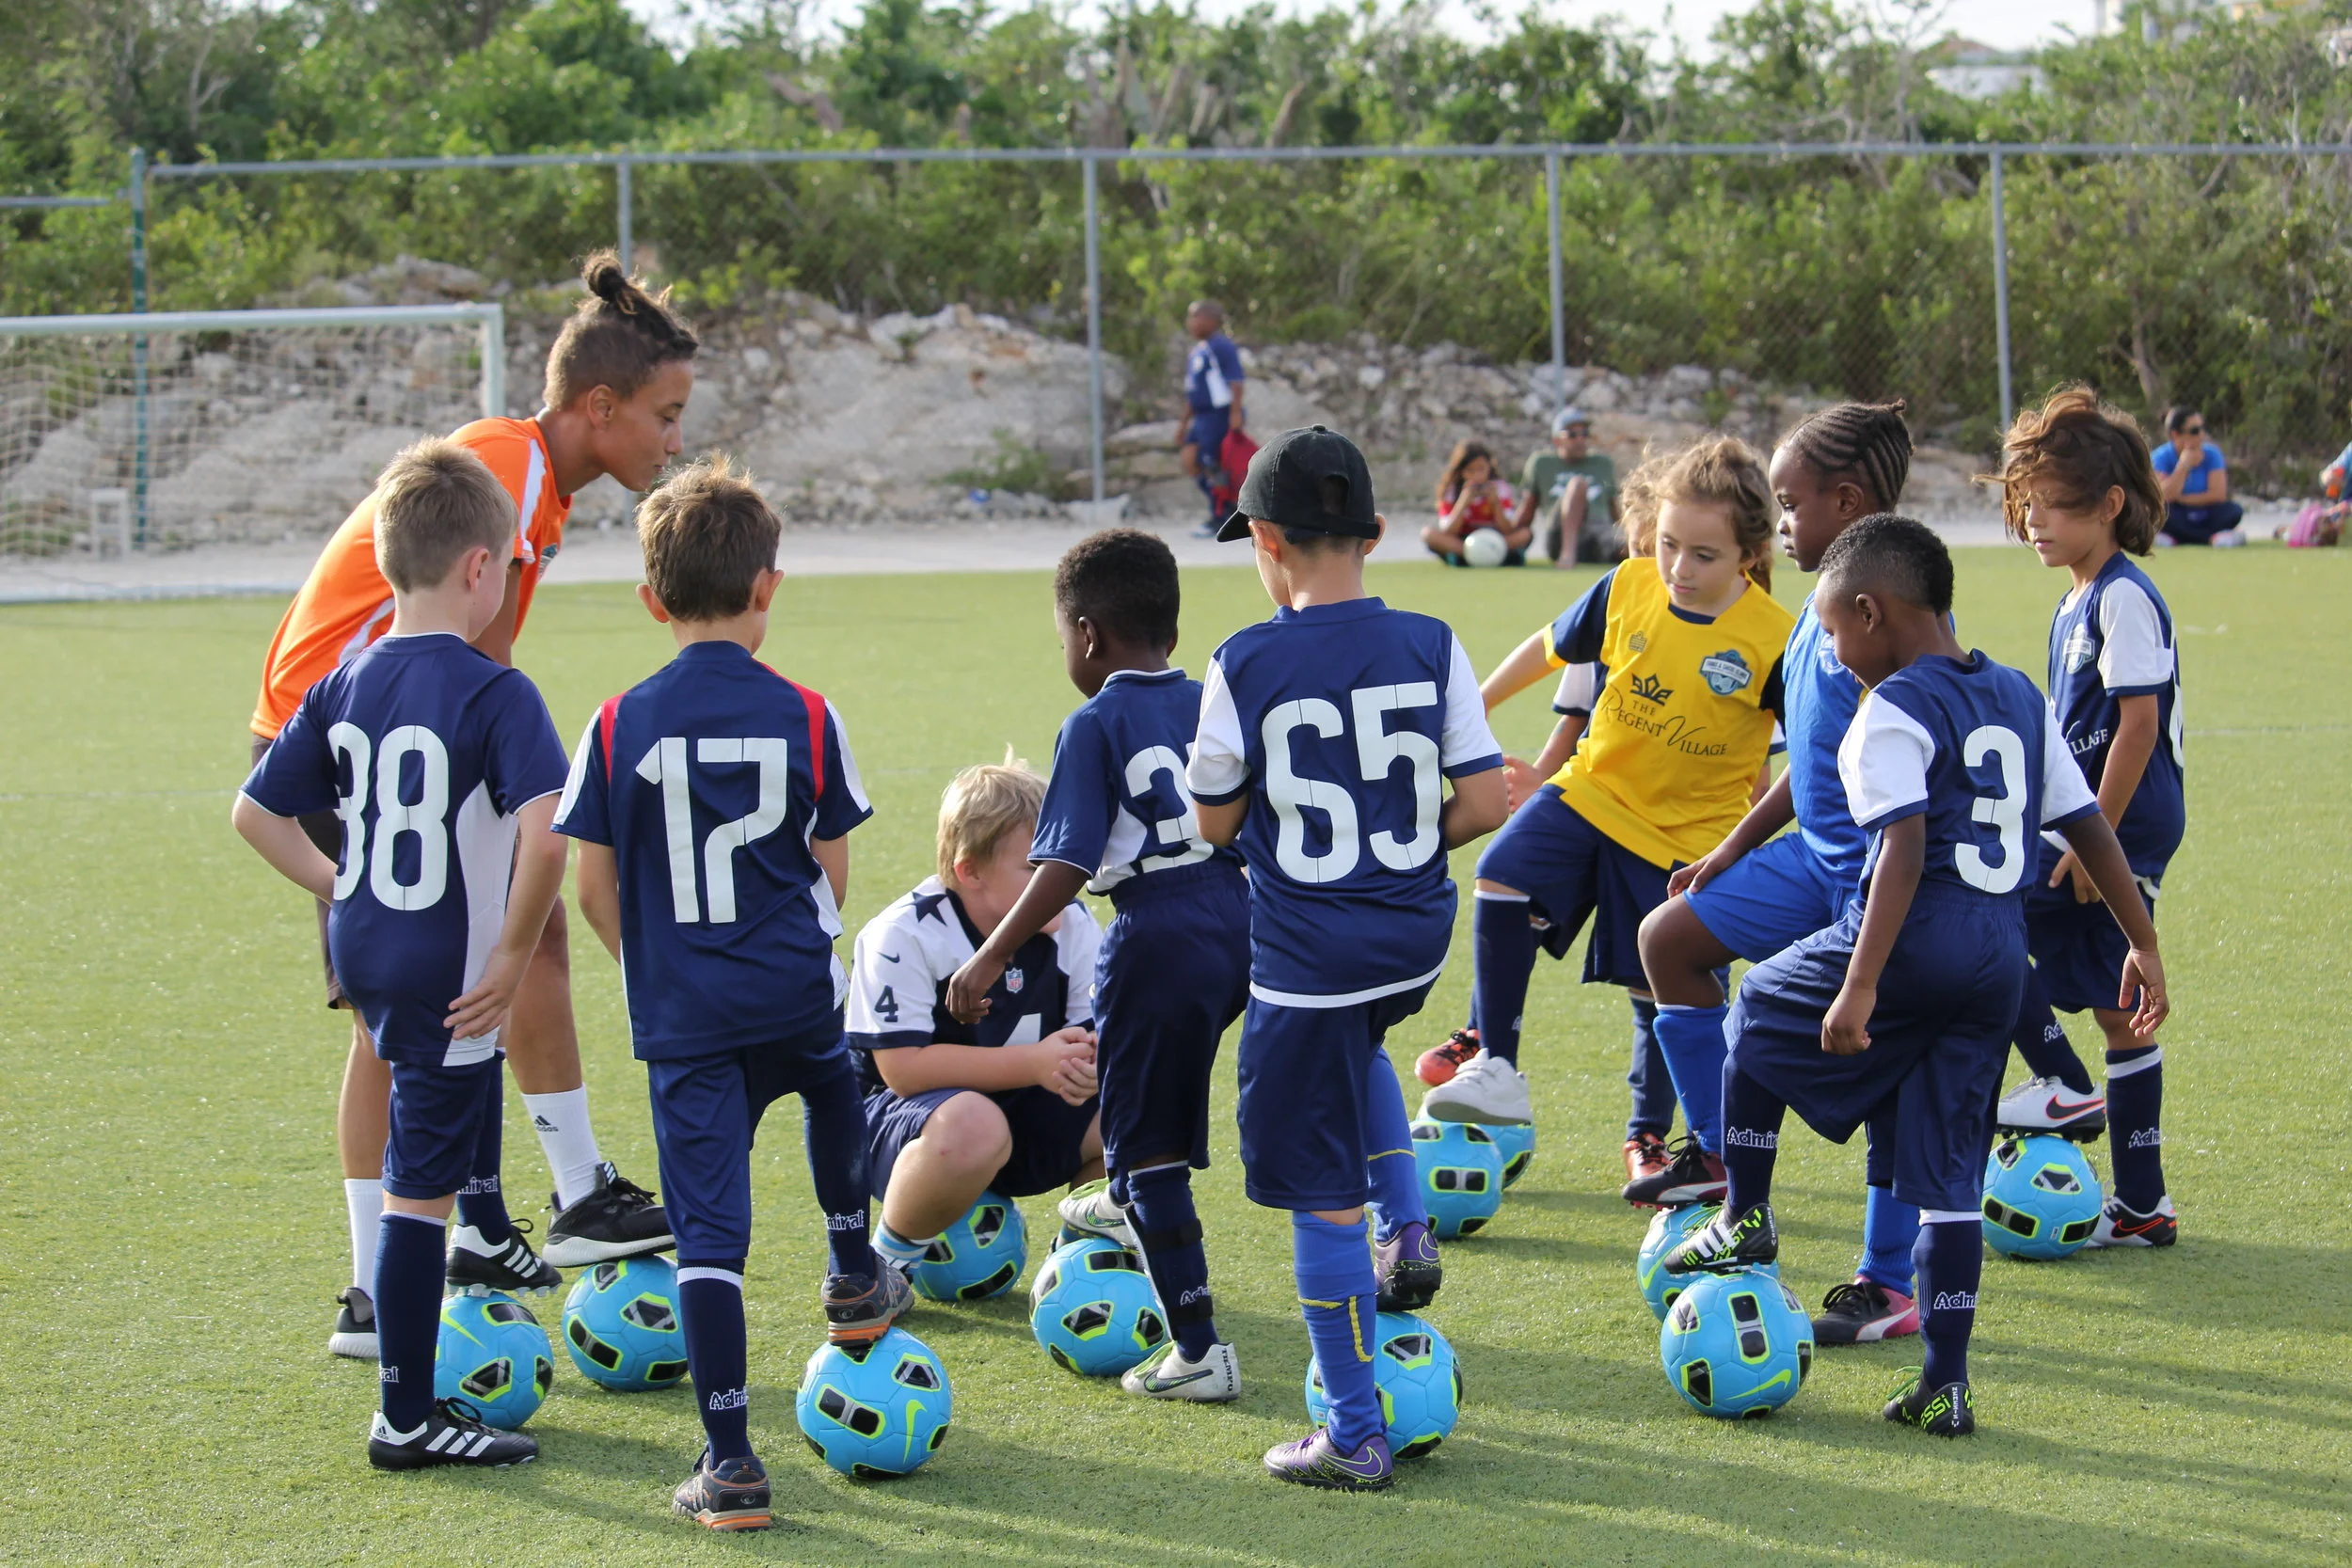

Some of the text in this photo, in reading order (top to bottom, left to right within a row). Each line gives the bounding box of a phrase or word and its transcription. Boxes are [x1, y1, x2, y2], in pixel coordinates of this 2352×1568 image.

[1600, 683, 1728, 756] REGENT VILLAGE
[1632, 700, 1657, 716] THE
[635, 737, 787, 924] 17
[1124, 741, 1215, 874] 3
[1262, 681, 1442, 883] 65
[1954, 725, 2027, 894] 3
[874, 985, 898, 1022] 4
